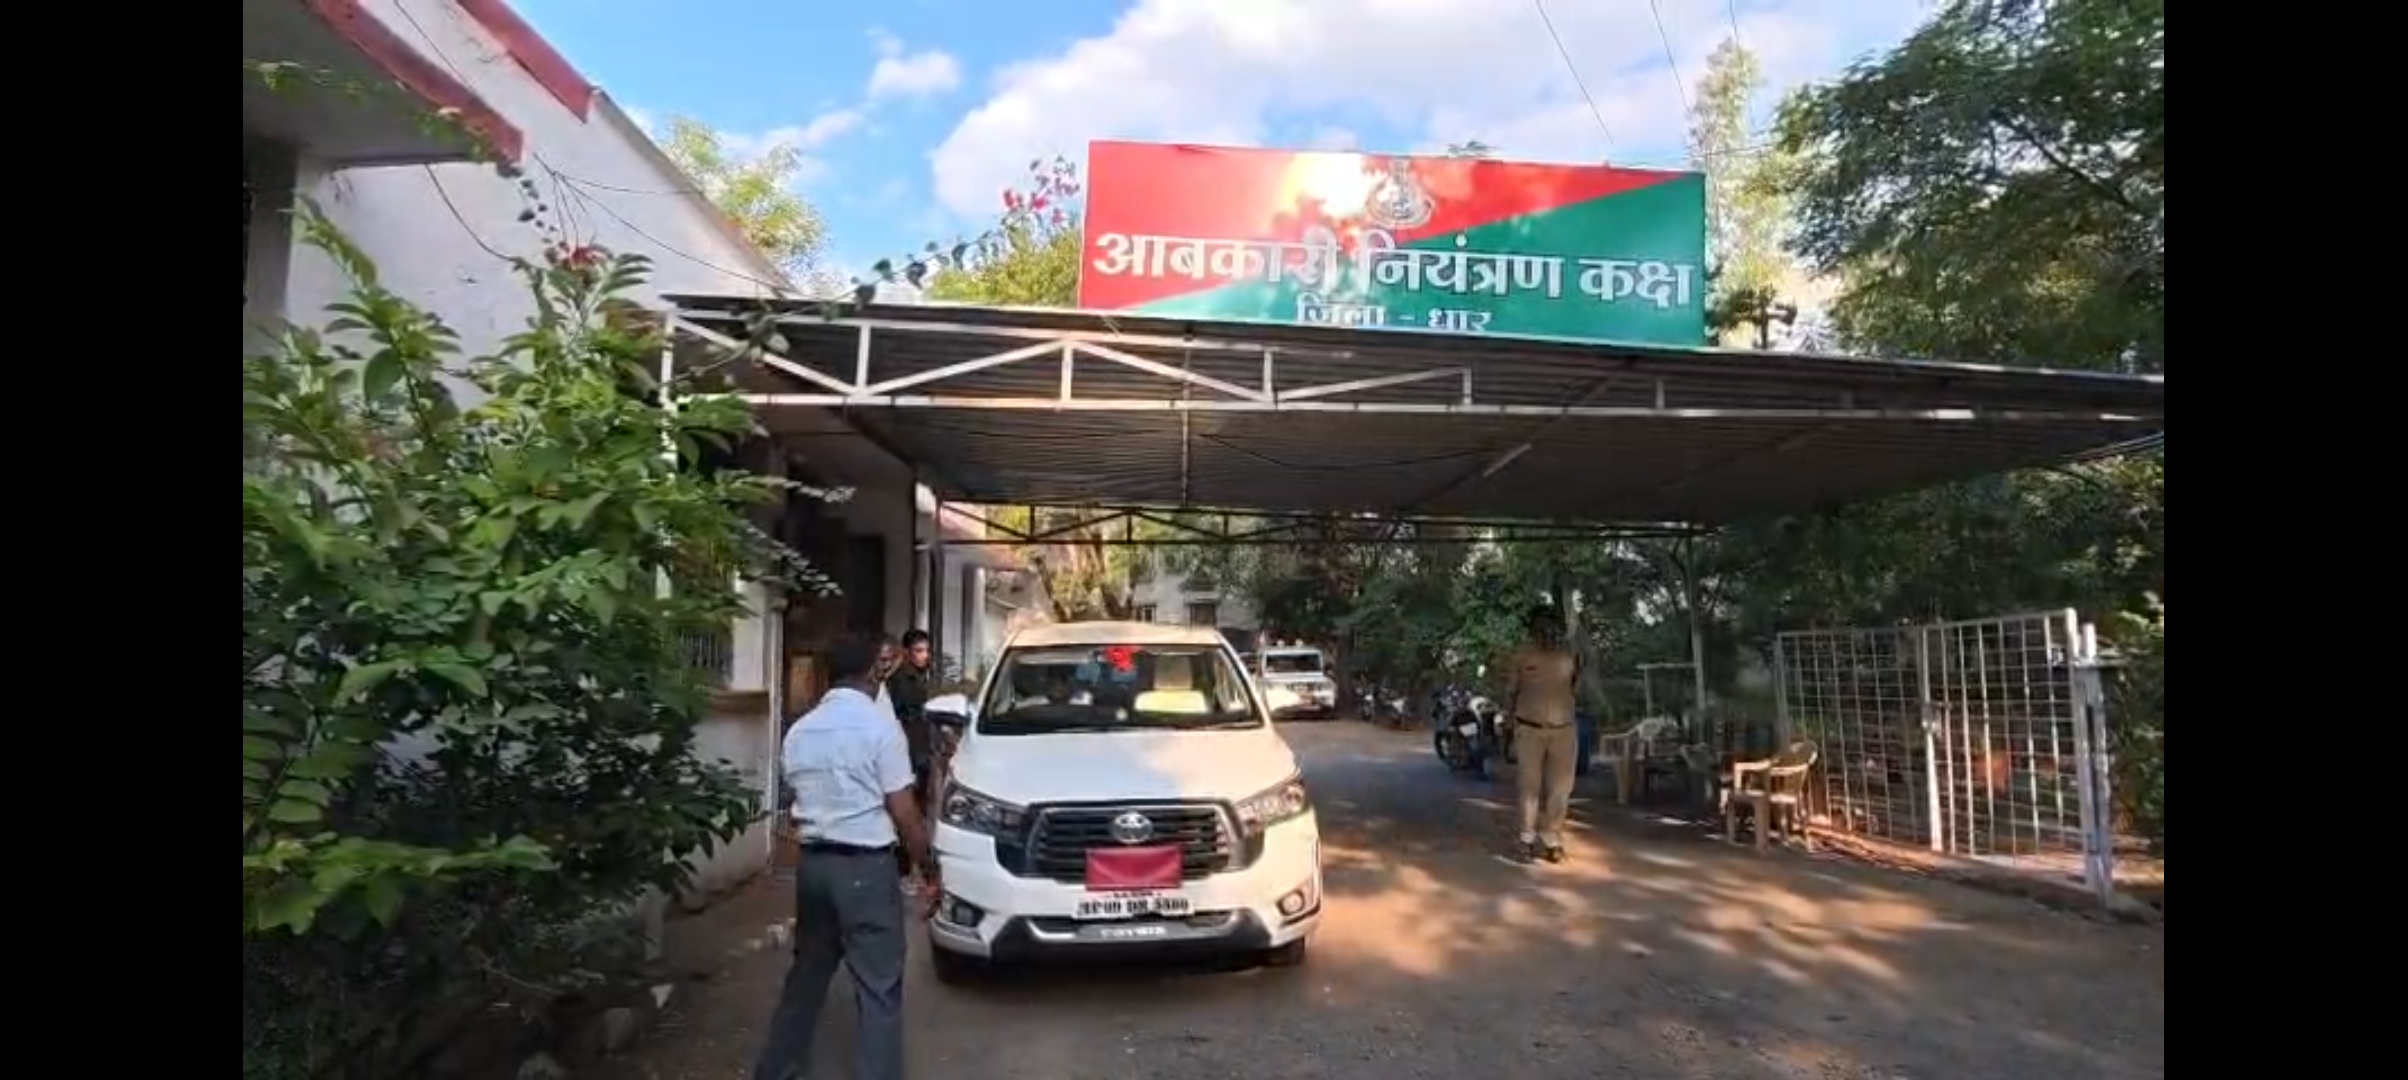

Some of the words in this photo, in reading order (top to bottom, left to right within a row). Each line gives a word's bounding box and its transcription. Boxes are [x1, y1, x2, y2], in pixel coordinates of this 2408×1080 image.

[1092, 226, 1341, 295] आबकारी
[1355, 228, 1565, 297] नियंत्रण
[1577, 257, 1695, 308] कक्ष
[1295, 292, 1386, 325] जिला
